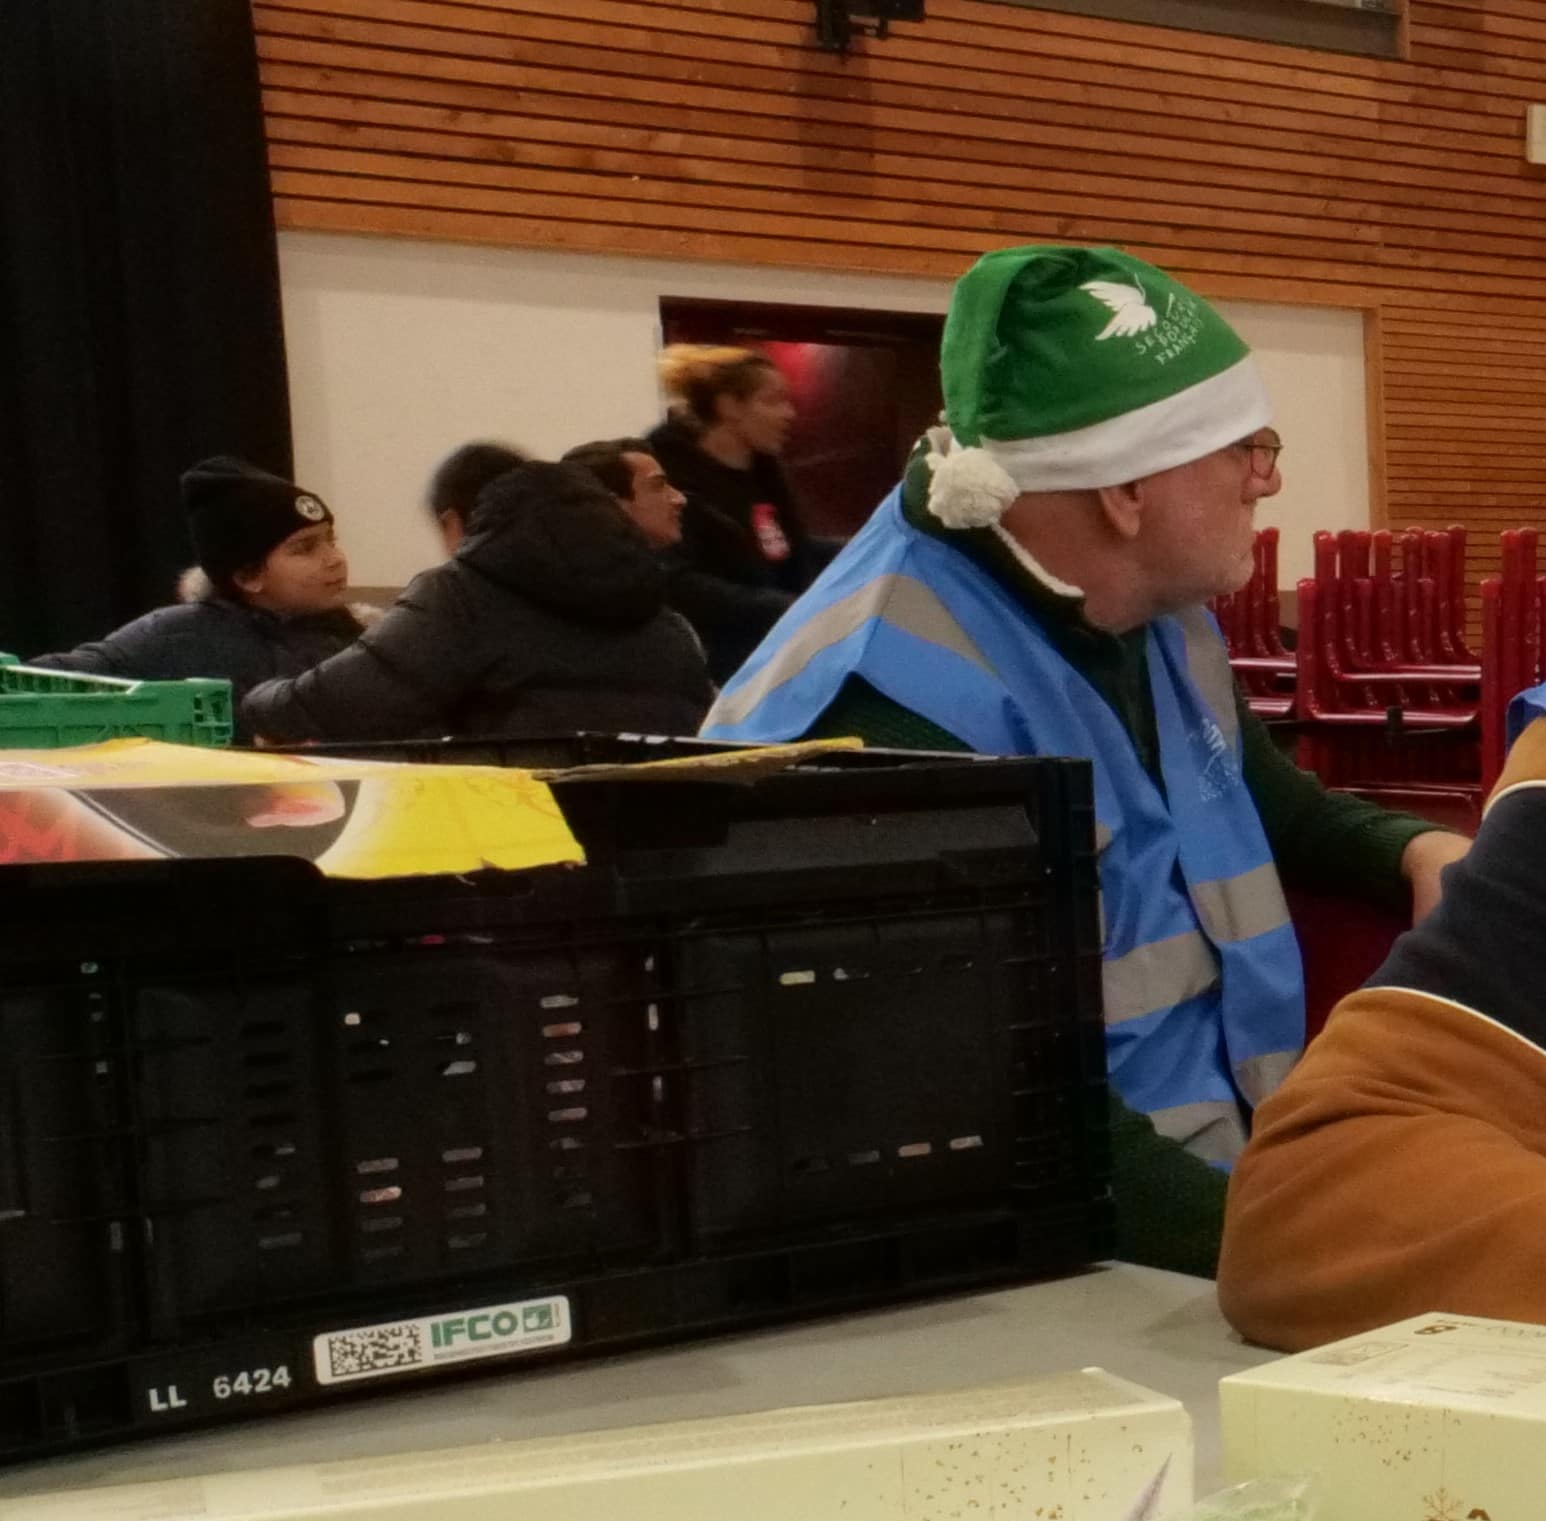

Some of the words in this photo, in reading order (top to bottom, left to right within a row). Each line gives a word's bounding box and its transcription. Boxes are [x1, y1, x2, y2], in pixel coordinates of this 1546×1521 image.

[430, 1311, 518, 1348] IFCO
[148, 1385, 187, 1412] LL
[212, 1366, 292, 1399] 6424
